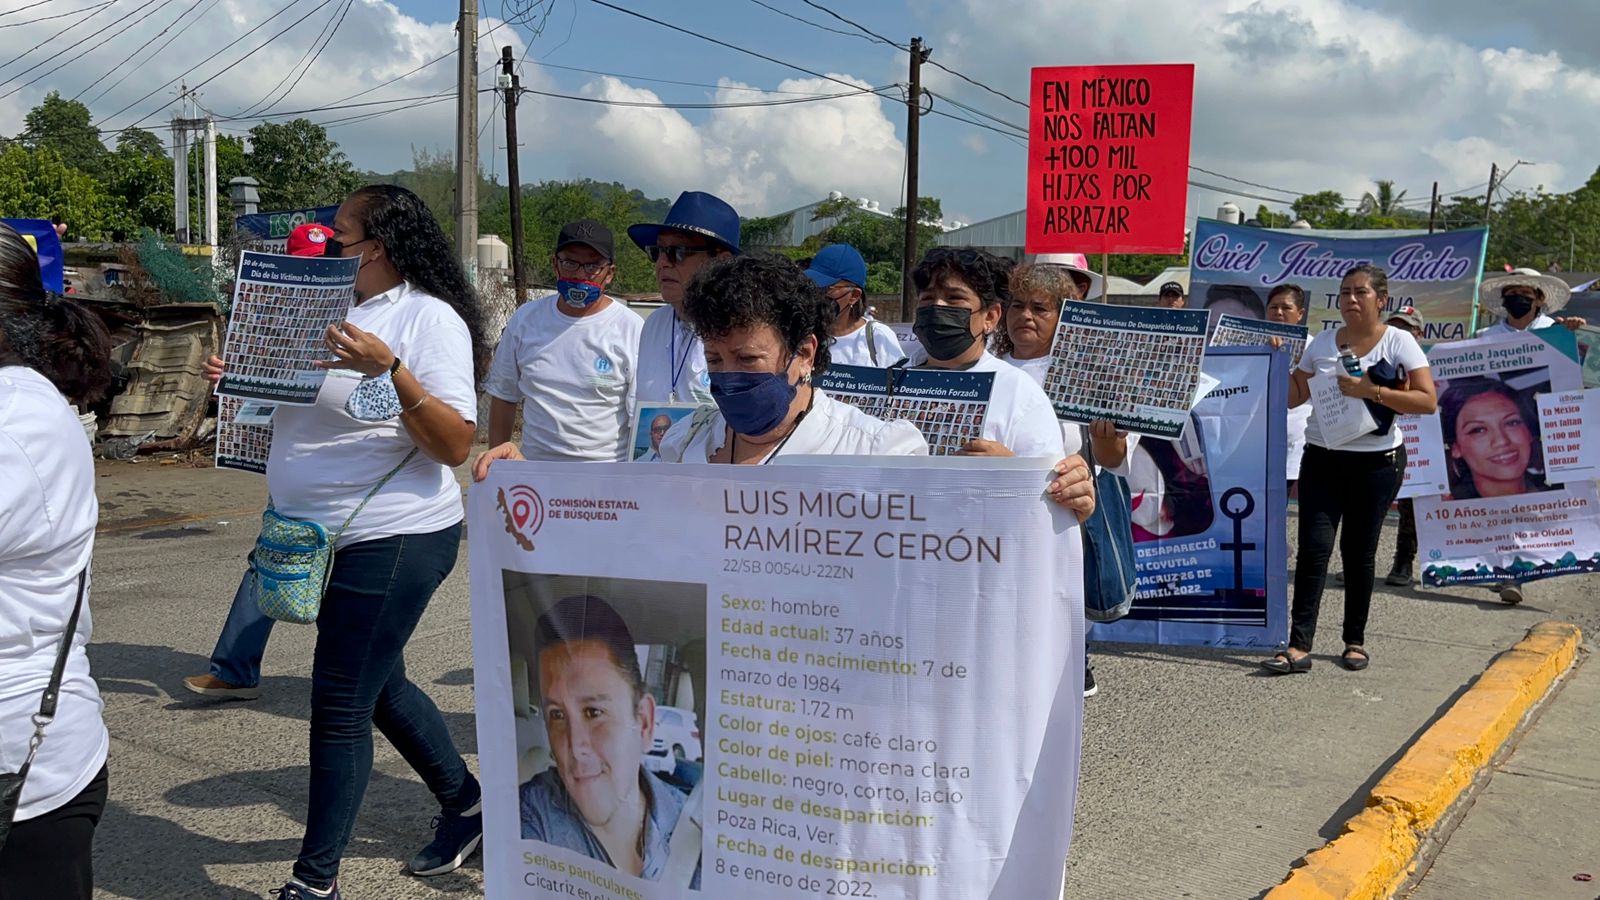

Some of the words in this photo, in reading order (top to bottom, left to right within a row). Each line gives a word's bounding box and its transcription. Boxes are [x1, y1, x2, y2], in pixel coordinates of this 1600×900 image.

[1043, 81, 1070, 112] EN
[1081, 75, 1150, 109] MÉXICO
[1044, 113, 1082, 142] NOS
[1093, 112, 1156, 140] FALTAN
[1044, 145, 1099, 171] +100
[1108, 145, 1138, 169] MIL
[1043, 173, 1101, 201] HIJXS
[1113, 174, 1151, 200] POR
[1043, 206, 1129, 235] ABRAZAR
[1195, 233, 1268, 272] Osiel
[1385, 243, 1470, 281] Isidro
[1488, 342, 1544, 359] Jaqueline
[1438, 360, 1485, 377] Jiménez
[1490, 356, 1533, 369] Estrella
[858, 382, 887, 392] Víctimas
[900, 386, 947, 397] Desaparición
[948, 389, 979, 398] Forzada
[549, 498, 596, 509] COMISIÓN
[598, 500, 640, 510] ESTATAL
[549, 510, 561, 519] DE
[564, 509, 618, 522] BÚSQUEDA
[724, 489, 789, 516] LUIS
[800, 491, 927, 522] MIGUEL
[1426, 512, 1433, 520] A
[1435, 508, 1450, 520] 10
[1454, 506, 1487, 519] Años
[1489, 507, 1499, 515] de
[1512, 498, 1587, 513] desaparición
[1446, 523, 1457, 531] en
[1460, 521, 1468, 530] la
[1470, 520, 1484, 529] Av.
[1486, 519, 1498, 528] 20
[1501, 516, 1513, 525] de
[1516, 512, 1568, 524] Noviembre
[1541, 528, 1573, 538] Olvida!
[724, 522, 864, 557] RAMÍREZ
[874, 528, 1001, 563] CERÓN
[1137, 538, 1216, 558] DESAPARECIÓ
[723, 559, 762, 575] 22/SB
[1135, 564, 1144, 572] N
[1146, 557, 1198, 571] COYUTLA
[1135, 573, 1179, 586] RACRUZ
[1181, 571, 1195, 581] 26
[1197, 568, 1212, 578] DE
[721, 594, 765, 612] Sexo:
[771, 598, 840, 618] hombre
[1136, 589, 1171, 600] ABRIL
[1174, 584, 1201, 596] 2022
[721, 618, 764, 636] Edad
[769, 624, 829, 642] actual:
[834, 627, 854, 644] 37
[860, 630, 904, 650] años
[721, 642, 772, 661] Fecha
[778, 647, 798, 664] de
[804, 650, 917, 675] nacimiento:
[922, 660, 935, 677] 7
[941, 662, 967, 679] de
[721, 667, 772, 686] marzo
[776, 672, 798, 689] de
[802, 674, 841, 694] 1984
[720, 689, 796, 713] Estatura:
[800, 699, 830, 719] 1.72
[836, 706, 854, 721] m
[718, 713, 763, 733] Color
[768, 720, 790, 737] de
[795, 724, 837, 745] ojos:
[842, 731, 882, 747] café
[888, 734, 937, 753] claro
[718, 738, 762, 758] Color
[768, 746, 790, 763] de
[795, 750, 834, 769] piel:
[840, 758, 915, 778] morena
[921, 761, 971, 780] clara
[718, 762, 787, 786] Cabello:
[792, 775, 848, 798] negro,
[854, 783, 909, 804] corto,
[916, 786, 964, 805] lacio
[717, 786, 766, 808] Lugar
[772, 796, 794, 812] de
[800, 800, 934, 827] desaparición:
[717, 810, 756, 831] Poza
[762, 816, 801, 840] Rica,
[806, 824, 839, 846] Ver.
[716, 834, 767, 857] Fecha
[773, 845, 795, 863] de
[800, 849, 937, 876] desaparición:
[522, 851, 565, 873] Señas
[569, 864, 642, 900] particulares:
[524, 872, 576, 896] Cicatriz
[715, 858, 726, 874] 8
[730, 864, 740, 877] e
[744, 866, 793, 888] enero
[798, 874, 821, 892] de
[826, 878, 878, 898] 2022.
